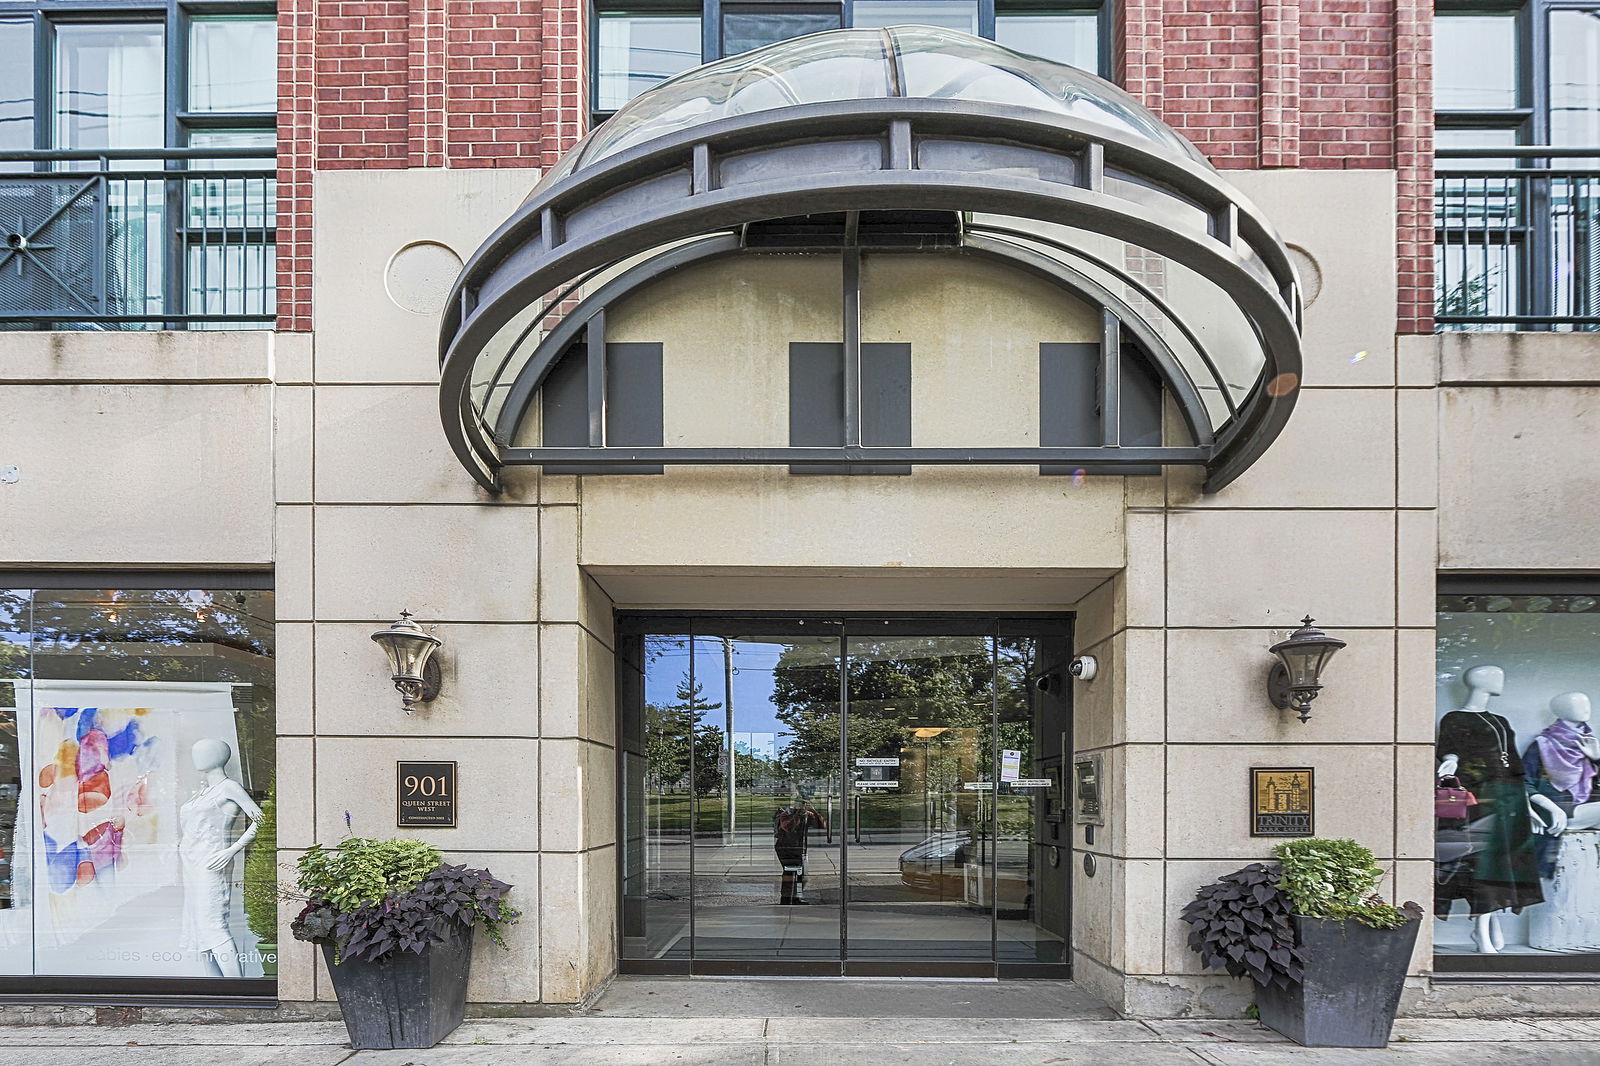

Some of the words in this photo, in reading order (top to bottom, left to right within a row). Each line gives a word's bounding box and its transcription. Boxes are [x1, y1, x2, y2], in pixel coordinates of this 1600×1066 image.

[404, 775, 448, 797] 901
[1257, 816, 1310, 826] TRINITY
[151, 951, 182, 962] eco
